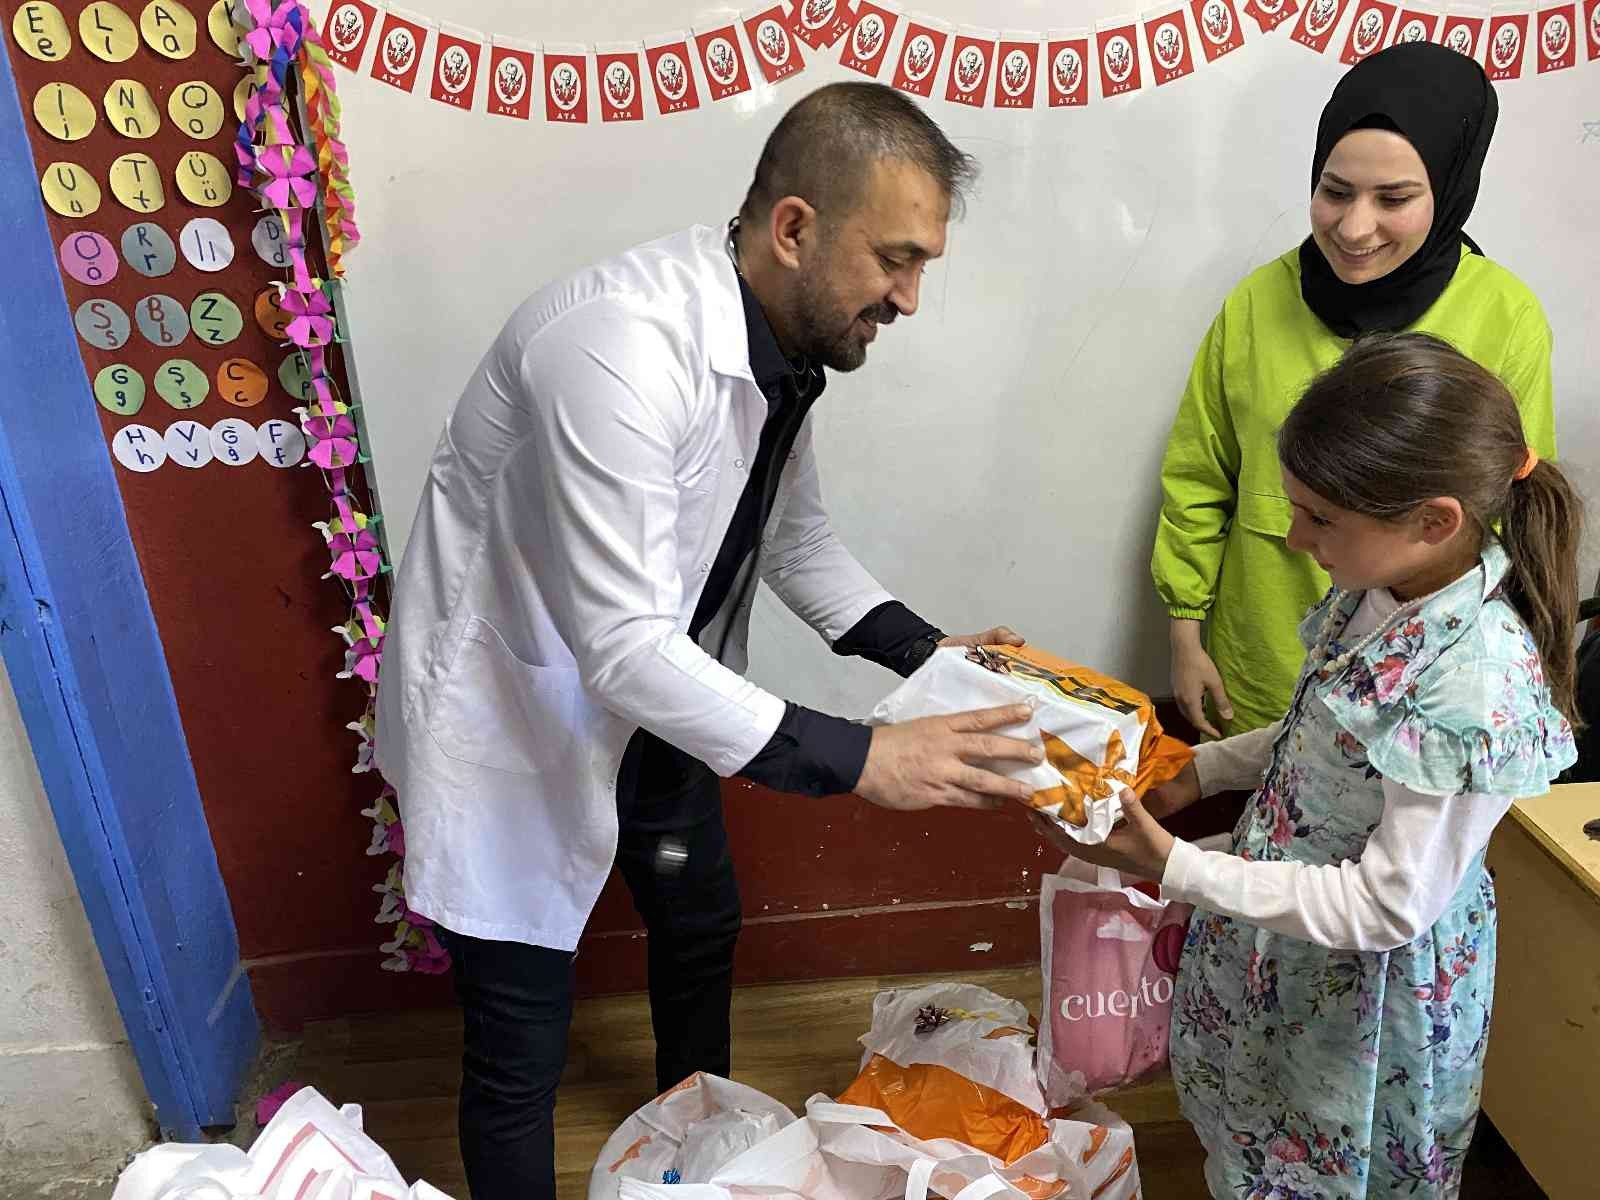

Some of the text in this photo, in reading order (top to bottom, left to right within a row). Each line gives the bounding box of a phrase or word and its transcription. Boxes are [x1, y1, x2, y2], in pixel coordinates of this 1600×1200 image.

[26, 7, 43, 34] E
[95, 8, 113, 31] L
[155, 6, 176, 27] A
[37, 38, 56, 57] e
[162, 34, 179, 53] a
[1299, 35, 1316, 47] ATA
[328, 50, 347, 63] ATA
[1216, 44, 1234, 56] ATA
[776, 65, 794, 78] ATA
[849, 60, 867, 72] ATA
[1547, 60, 1565, 70] ATA
[382, 74, 401, 87] ATA
[1166, 68, 1184, 80] ATA
[1493, 71, 1511, 79] ATA
[721, 86, 740, 96] ATA
[902, 82, 920, 92] ATA
[1112, 82, 1131, 93] ATA
[119, 86, 135, 108] N
[182, 85, 208, 108] O
[441, 94, 460, 105] ATA
[955, 94, 973, 103] ATA
[1004, 98, 1023, 106] ATA
[1058, 97, 1078, 105] ATA
[498, 106, 518, 115] ATA
[669, 101, 688, 110] ATA
[557, 112, 576, 120] ATA
[613, 111, 632, 119] ATA
[125, 116, 141, 134] n
[189, 118, 203, 134] o
[123, 159, 147, 182] T
[189, 154, 207, 177] Ü
[57, 168, 77, 190] U
[202, 181, 216, 201] ü
[70, 200, 83, 213] u
[133, 190, 150, 209] t
[137, 227, 152, 247] R
[265, 221, 280, 240] D
[273, 242, 284, 264] d
[143, 255, 156, 271] r
[91, 302, 112, 330] S
[148, 297, 165, 323] B
[200, 299, 223, 321] Z
[106, 331, 118, 347] s
[160, 322, 173, 343] b
[208, 329, 224, 342] z
[111, 368, 128, 385] G
[226, 362, 245, 381] C
[115, 390, 127, 406] g
[234, 390, 248, 402] c
[126, 428, 146, 444] H
[176, 424, 195, 442] V
[269, 423, 282, 443] F
[136, 449, 155, 464] h
[186, 449, 198, 461] v
[274, 448, 286, 464] f
